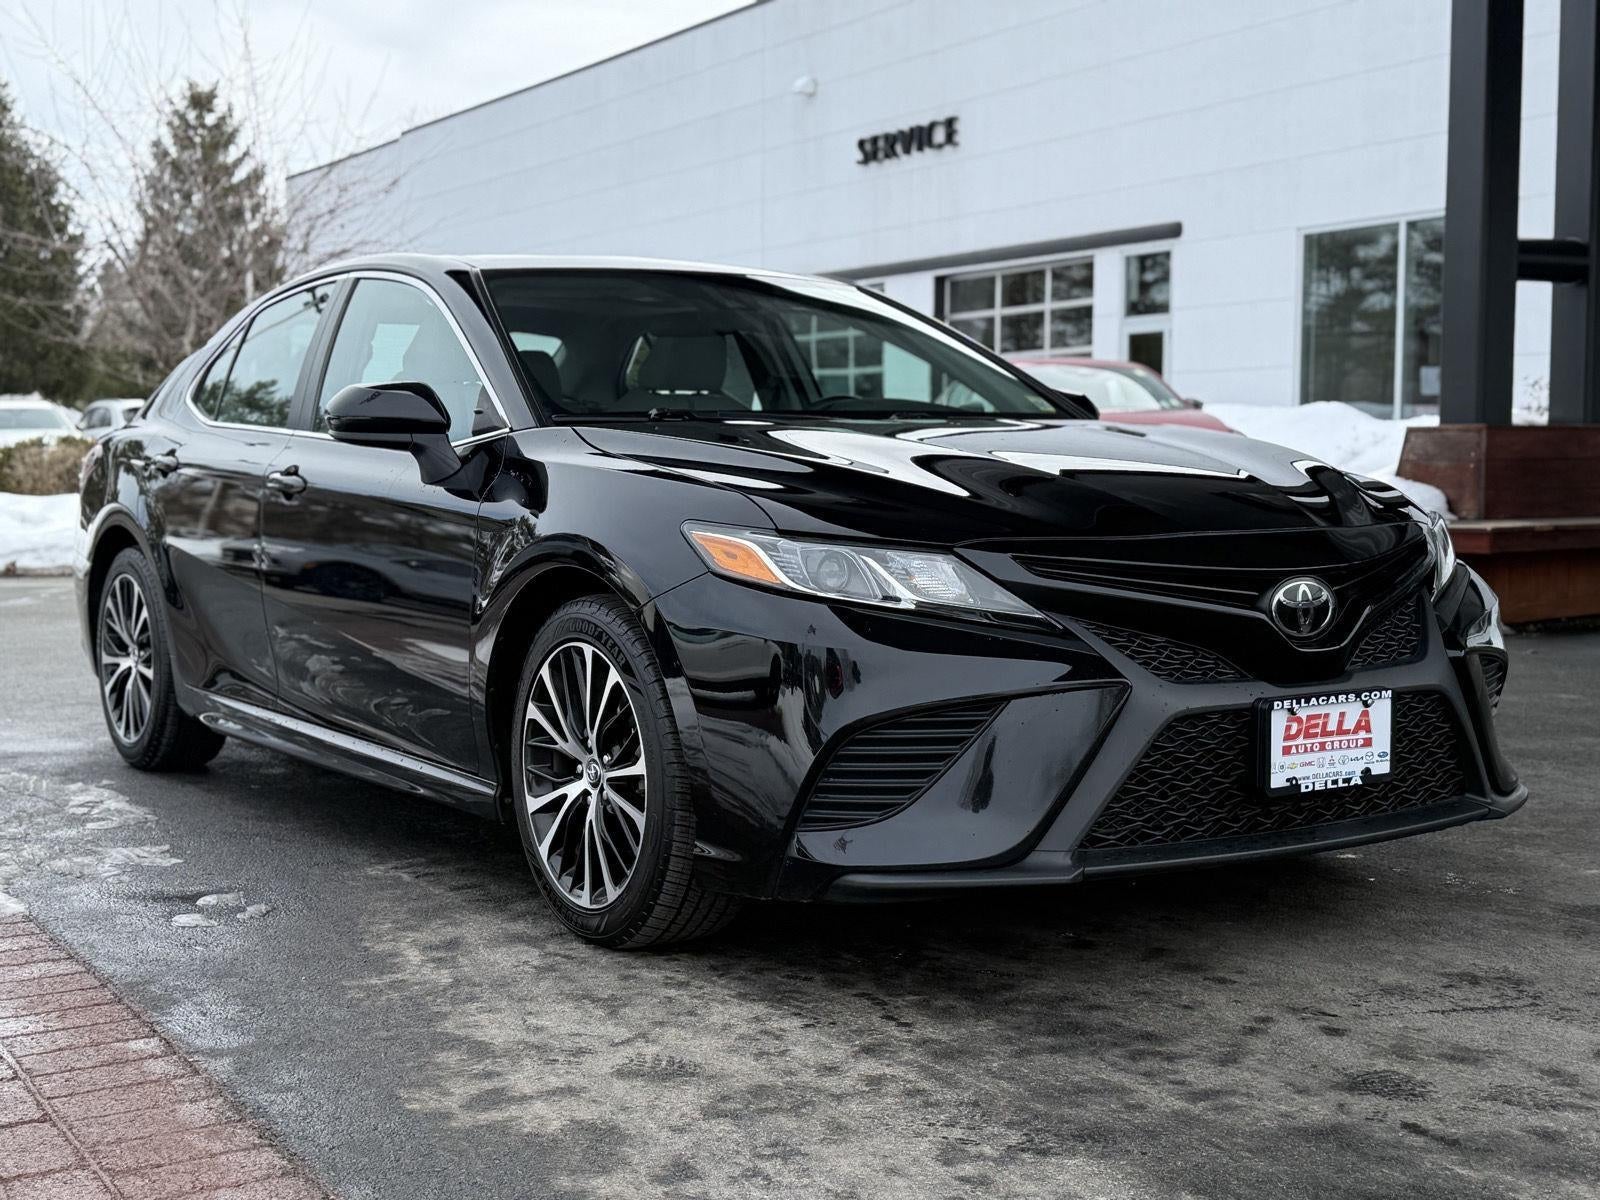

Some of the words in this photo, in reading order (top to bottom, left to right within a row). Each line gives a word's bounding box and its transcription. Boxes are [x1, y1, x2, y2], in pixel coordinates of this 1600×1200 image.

[856, 116, 960, 165] SERVICE
[1273, 689, 1392, 711] DELLACARS.COM
[1282, 709, 1372, 742] DELLA
[1290, 742, 1320, 754] AUTO
[1325, 739, 1364, 750] GROUP
[1299, 760, 1316, 768] GMC
[1300, 776, 1363, 793] DELLA
